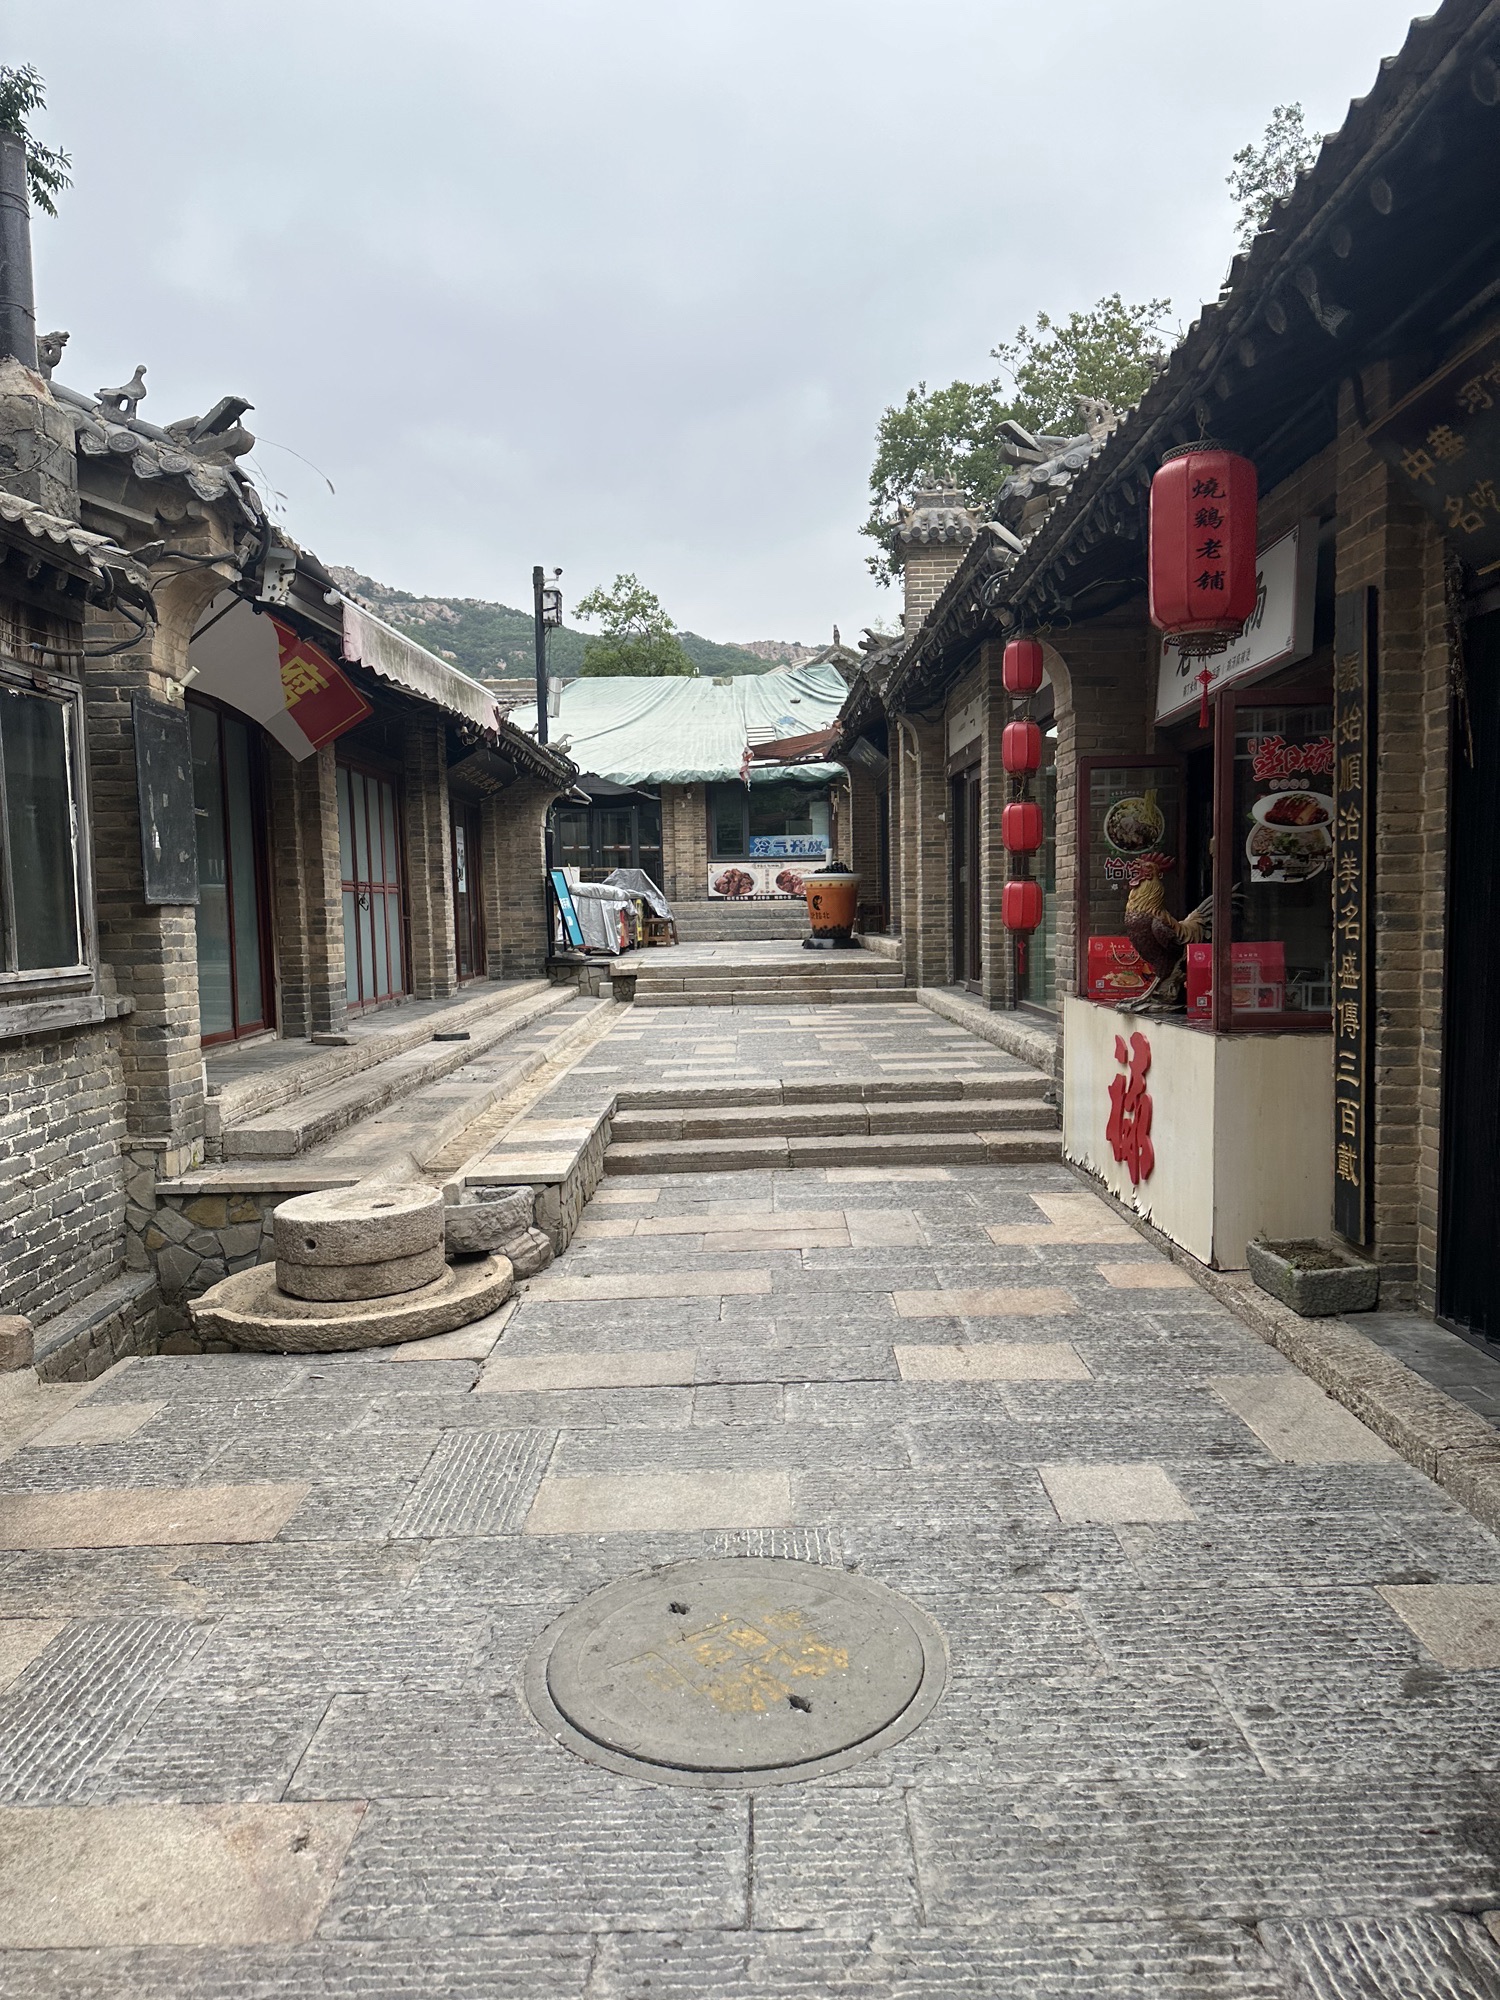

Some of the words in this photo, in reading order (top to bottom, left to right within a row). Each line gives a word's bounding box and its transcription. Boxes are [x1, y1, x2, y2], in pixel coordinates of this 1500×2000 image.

[1400, 424, 1467, 487] 中華
[1444, 479, 1500, 534] 名吃
[754, 838, 823, 854] 冷气开放
